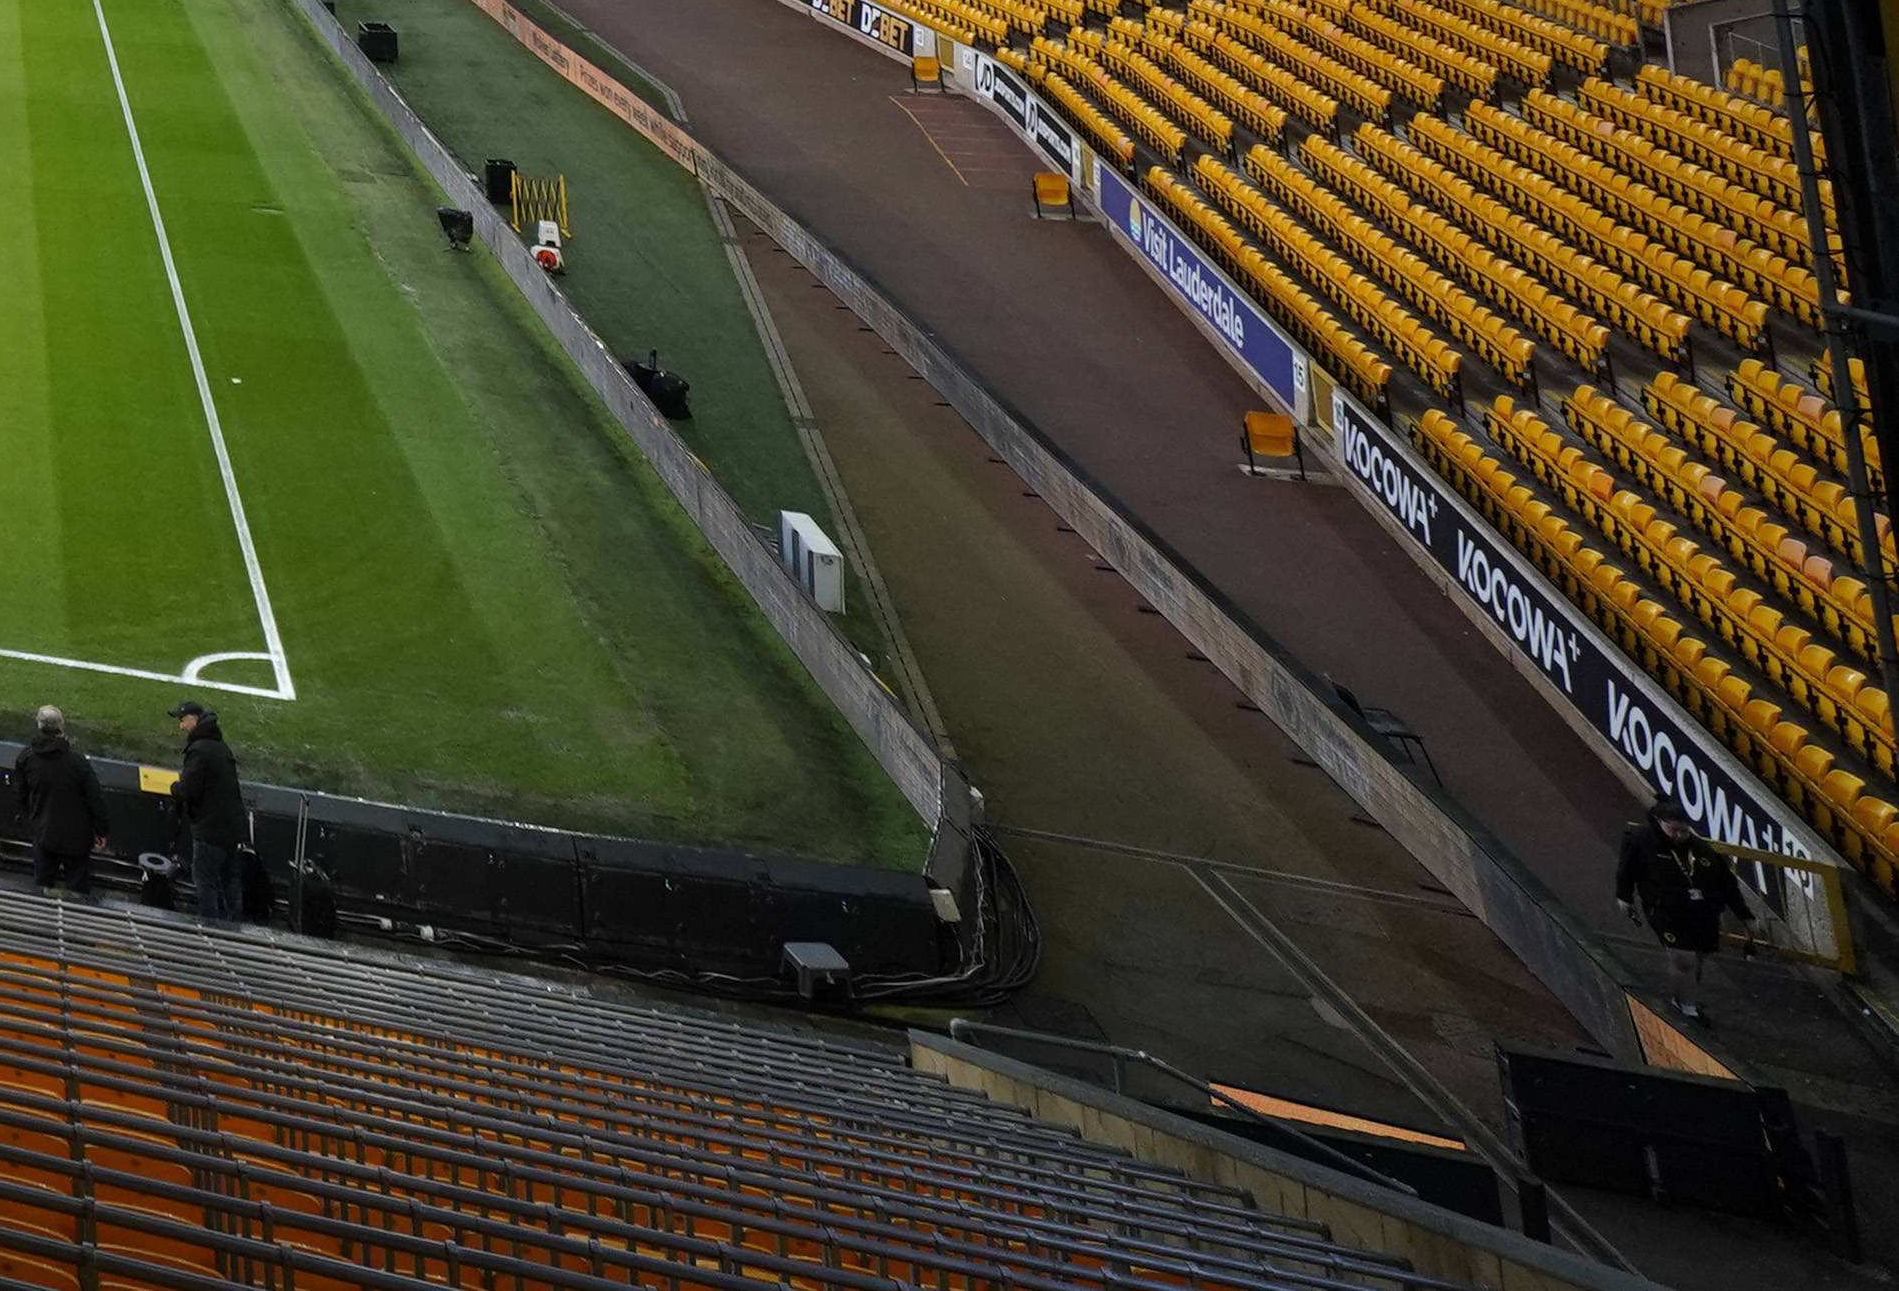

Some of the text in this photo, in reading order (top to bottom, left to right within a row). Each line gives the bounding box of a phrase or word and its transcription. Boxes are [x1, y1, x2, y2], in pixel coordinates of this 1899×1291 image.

[1142, 212, 1244, 348] Visit Lauderdale
[1293, 359, 1305, 390] 15
[1343, 417, 1438, 545] KOCOWA+
[1457, 529, 1581, 693] KOCOWA+
